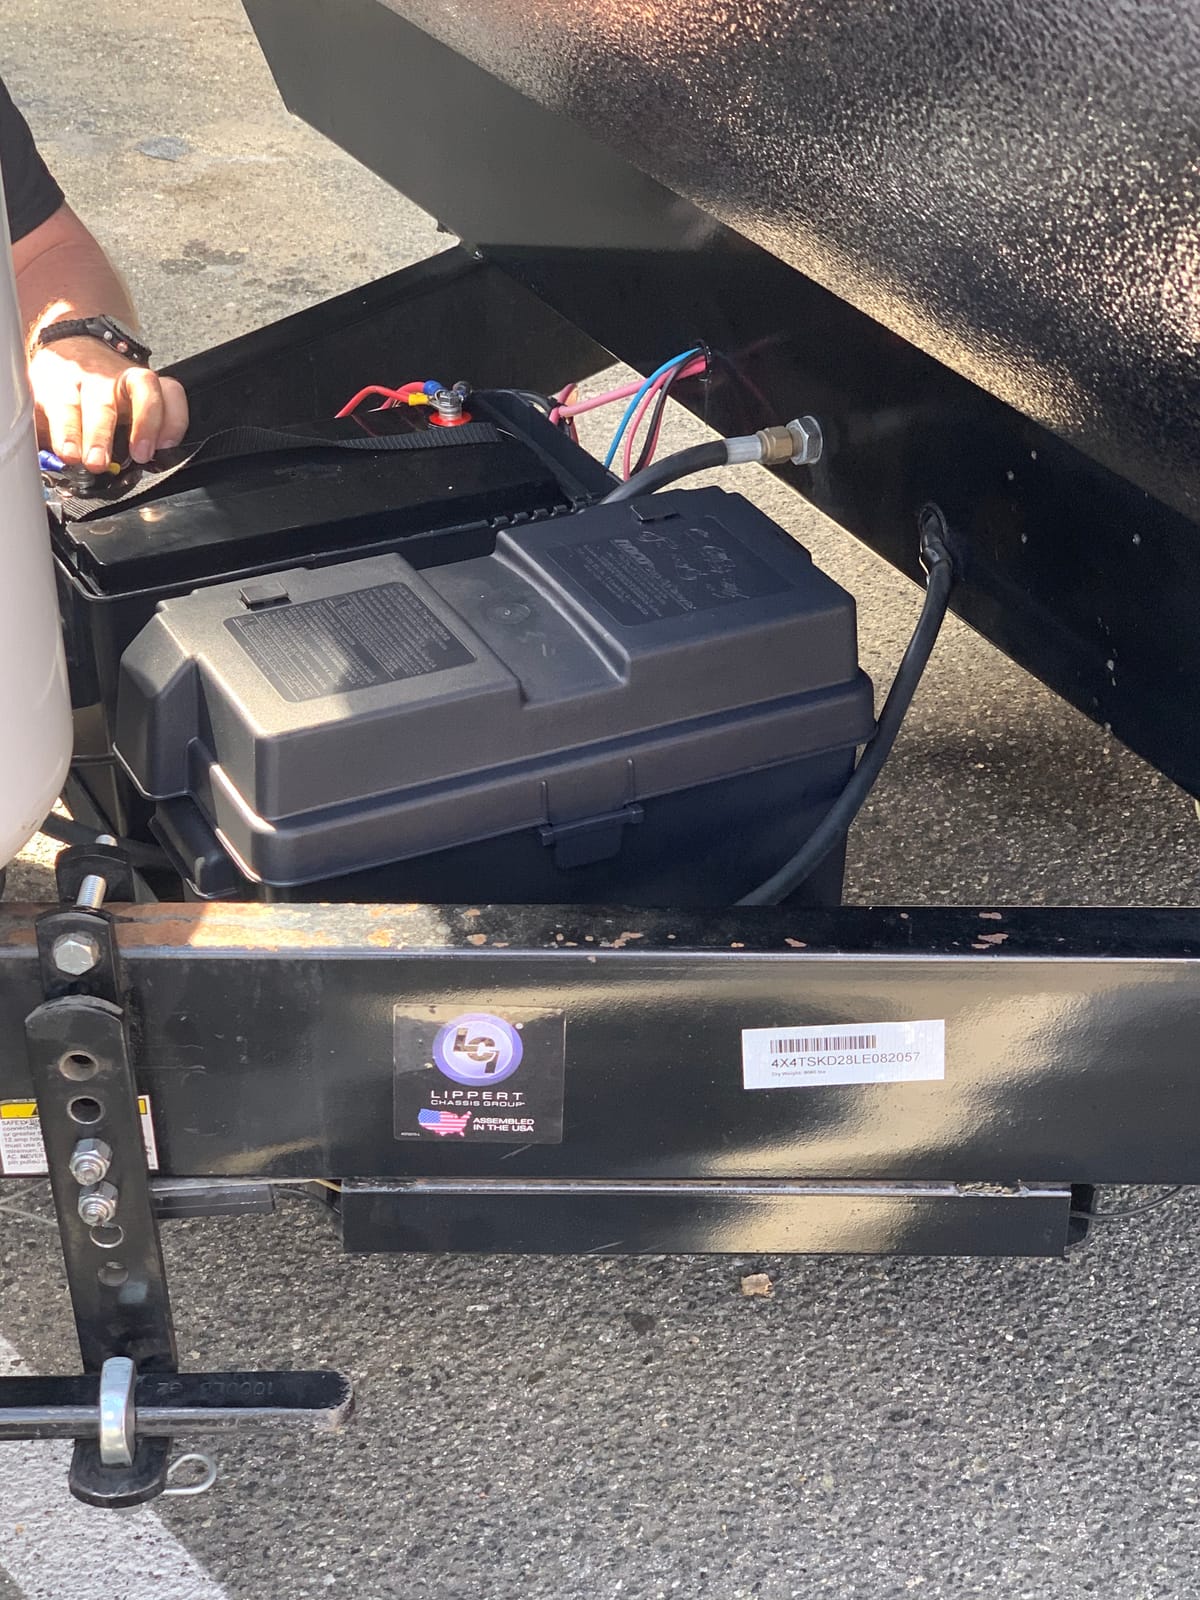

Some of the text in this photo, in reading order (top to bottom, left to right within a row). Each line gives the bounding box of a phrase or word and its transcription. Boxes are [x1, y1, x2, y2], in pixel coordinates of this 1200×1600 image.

[771, 1052, 921, 1068] 4X4TSKD28LE082057
[430, 1090, 524, 1100] LIPPERT
[472, 1117, 535, 1125] ASSEMBLED
